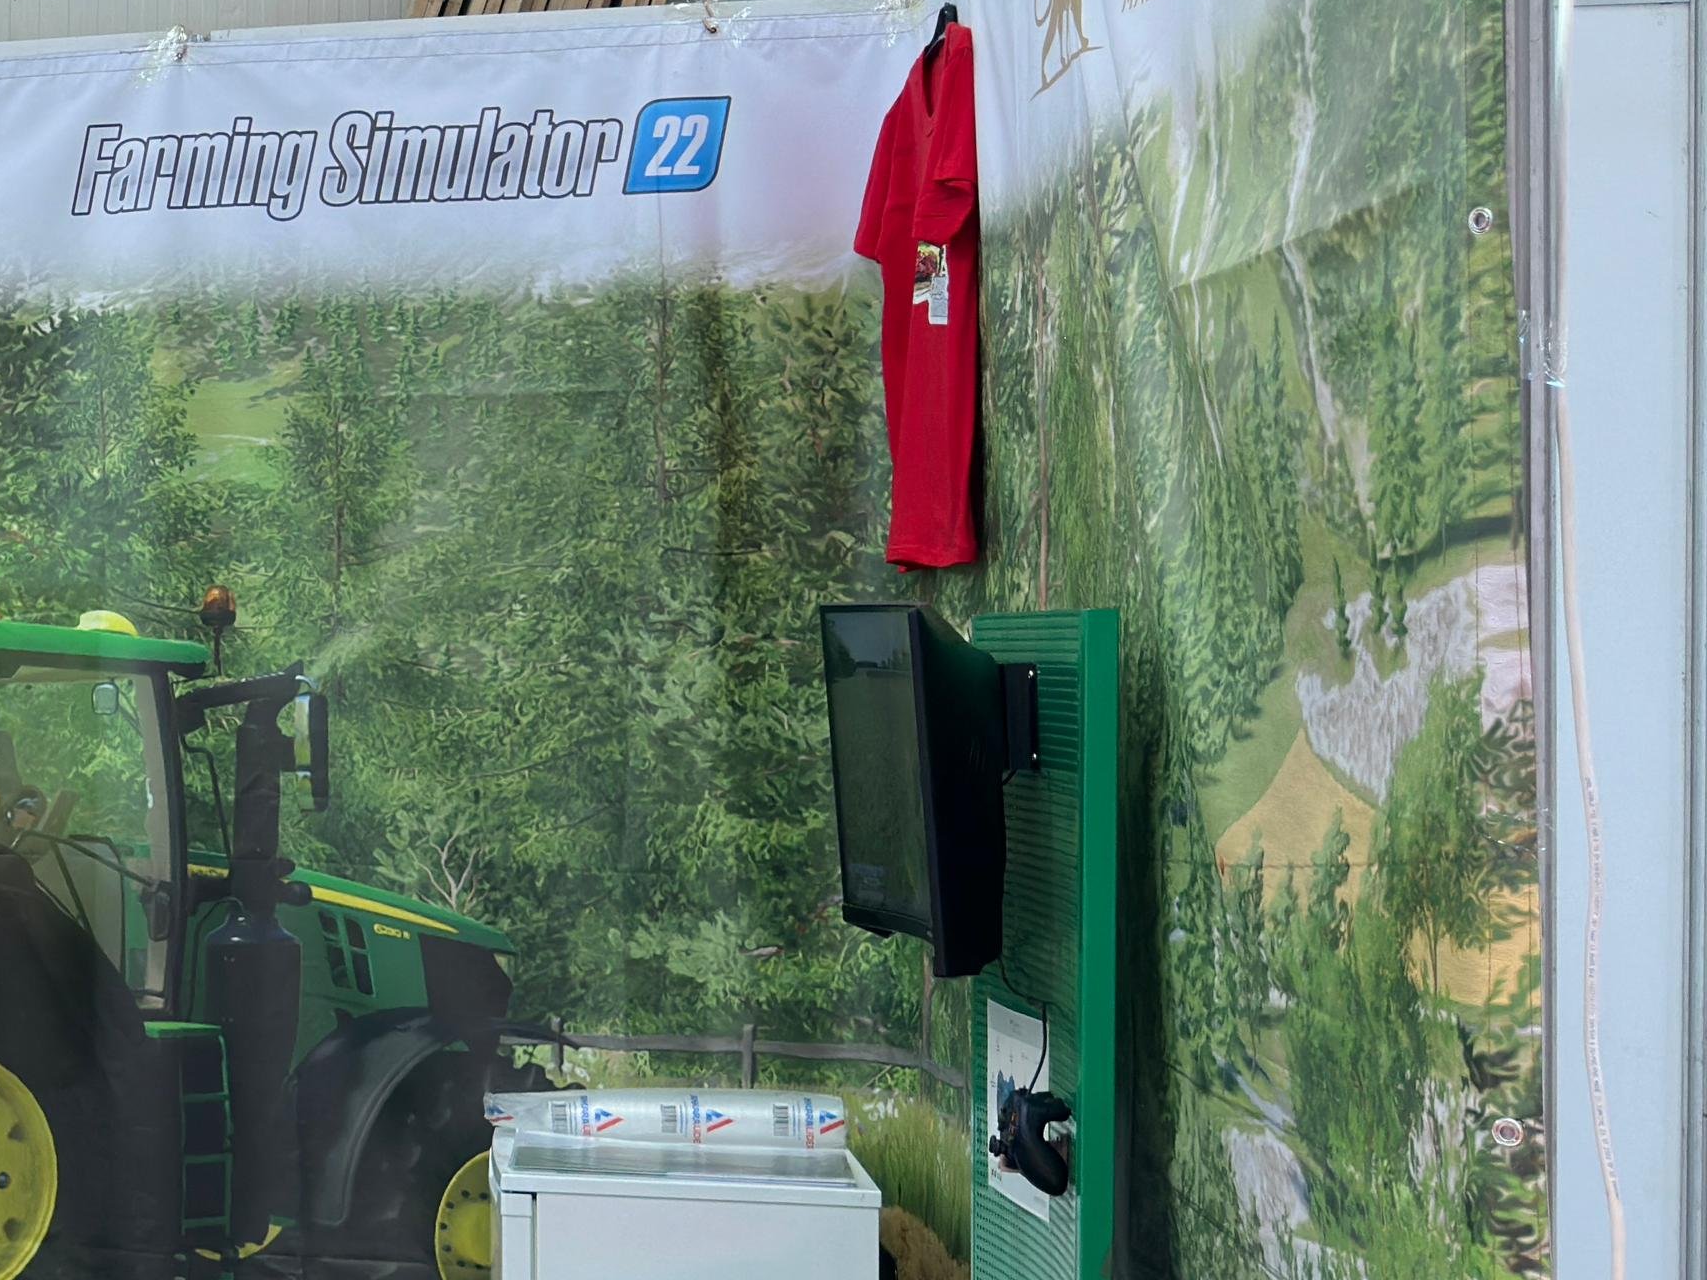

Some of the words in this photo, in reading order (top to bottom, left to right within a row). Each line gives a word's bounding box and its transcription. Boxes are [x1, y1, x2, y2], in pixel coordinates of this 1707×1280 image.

[71, 116, 317, 221] Farming
[319, 106, 623, 207] Simulator
[644, 113, 709, 178] 22
